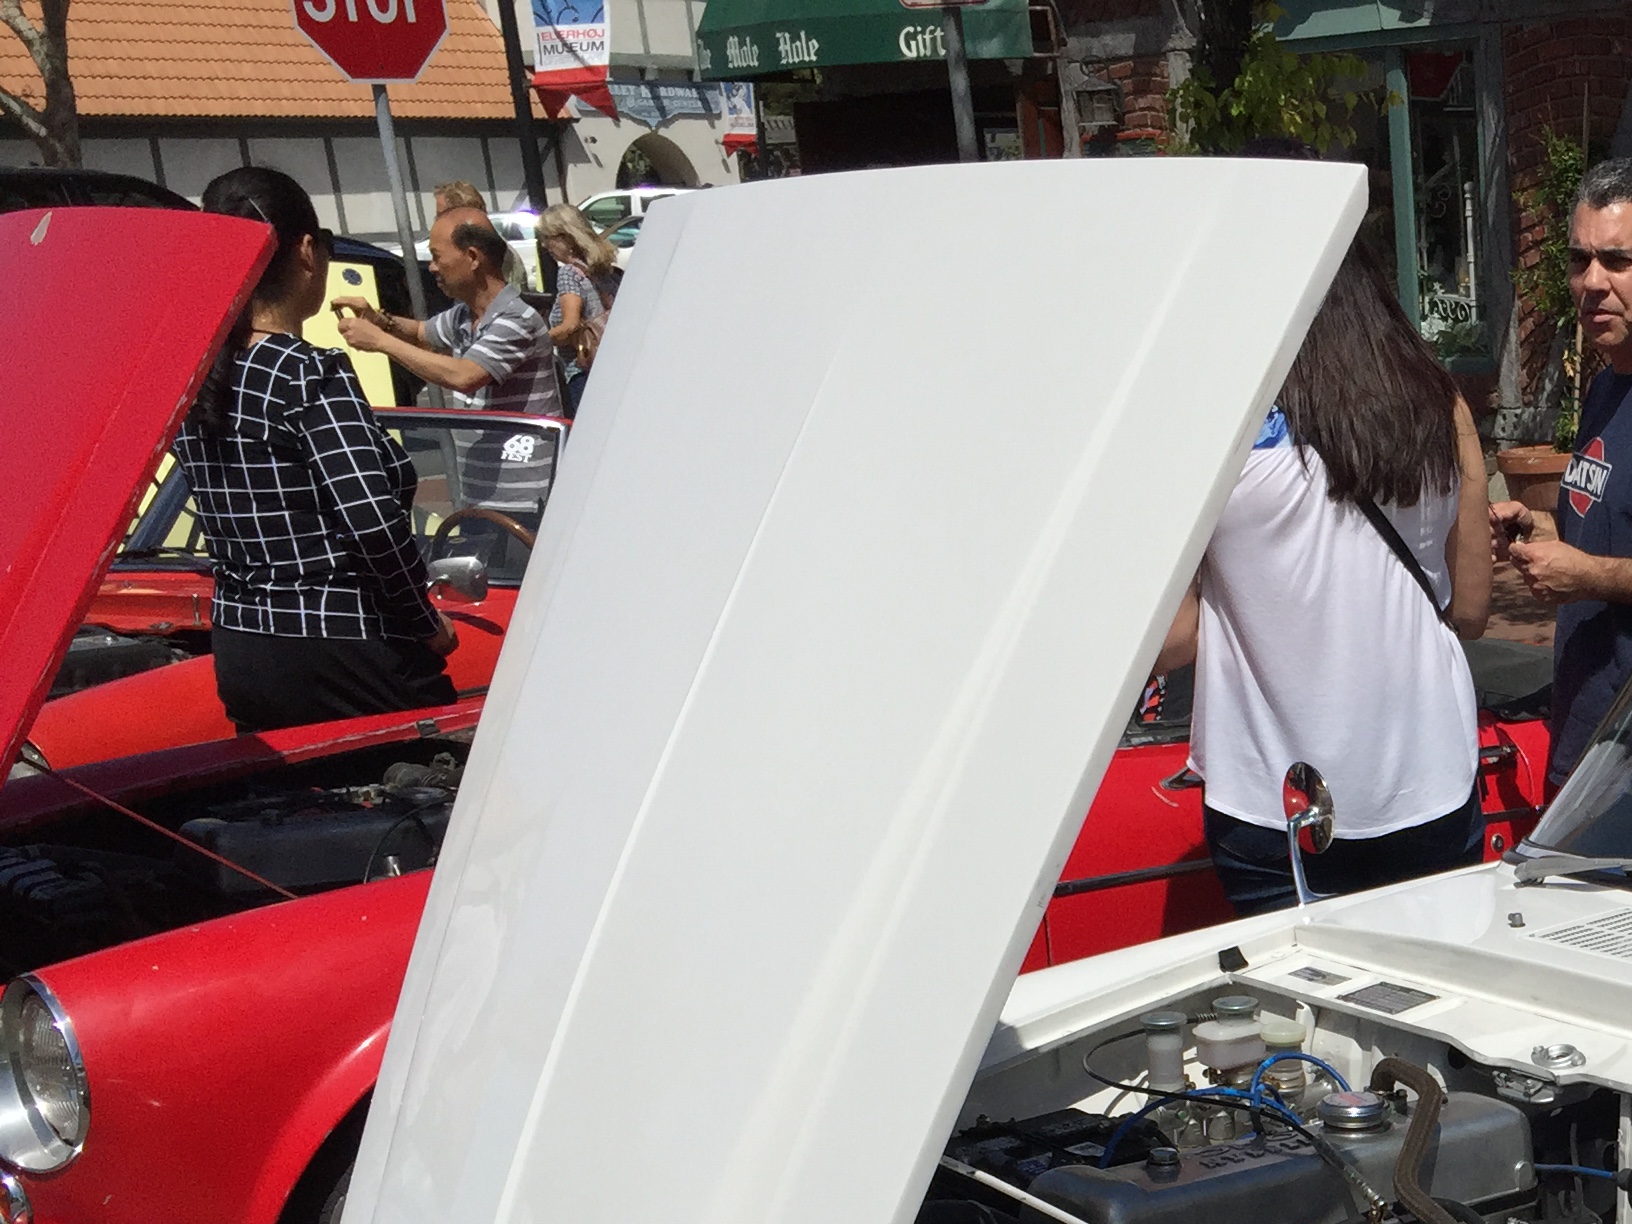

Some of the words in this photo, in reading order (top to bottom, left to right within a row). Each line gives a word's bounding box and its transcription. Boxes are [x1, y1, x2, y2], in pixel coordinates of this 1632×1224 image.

[543, 40, 605, 56] MUSEUM
[775, 31, 819, 64] Hole
[502, 434, 535, 456] 68
